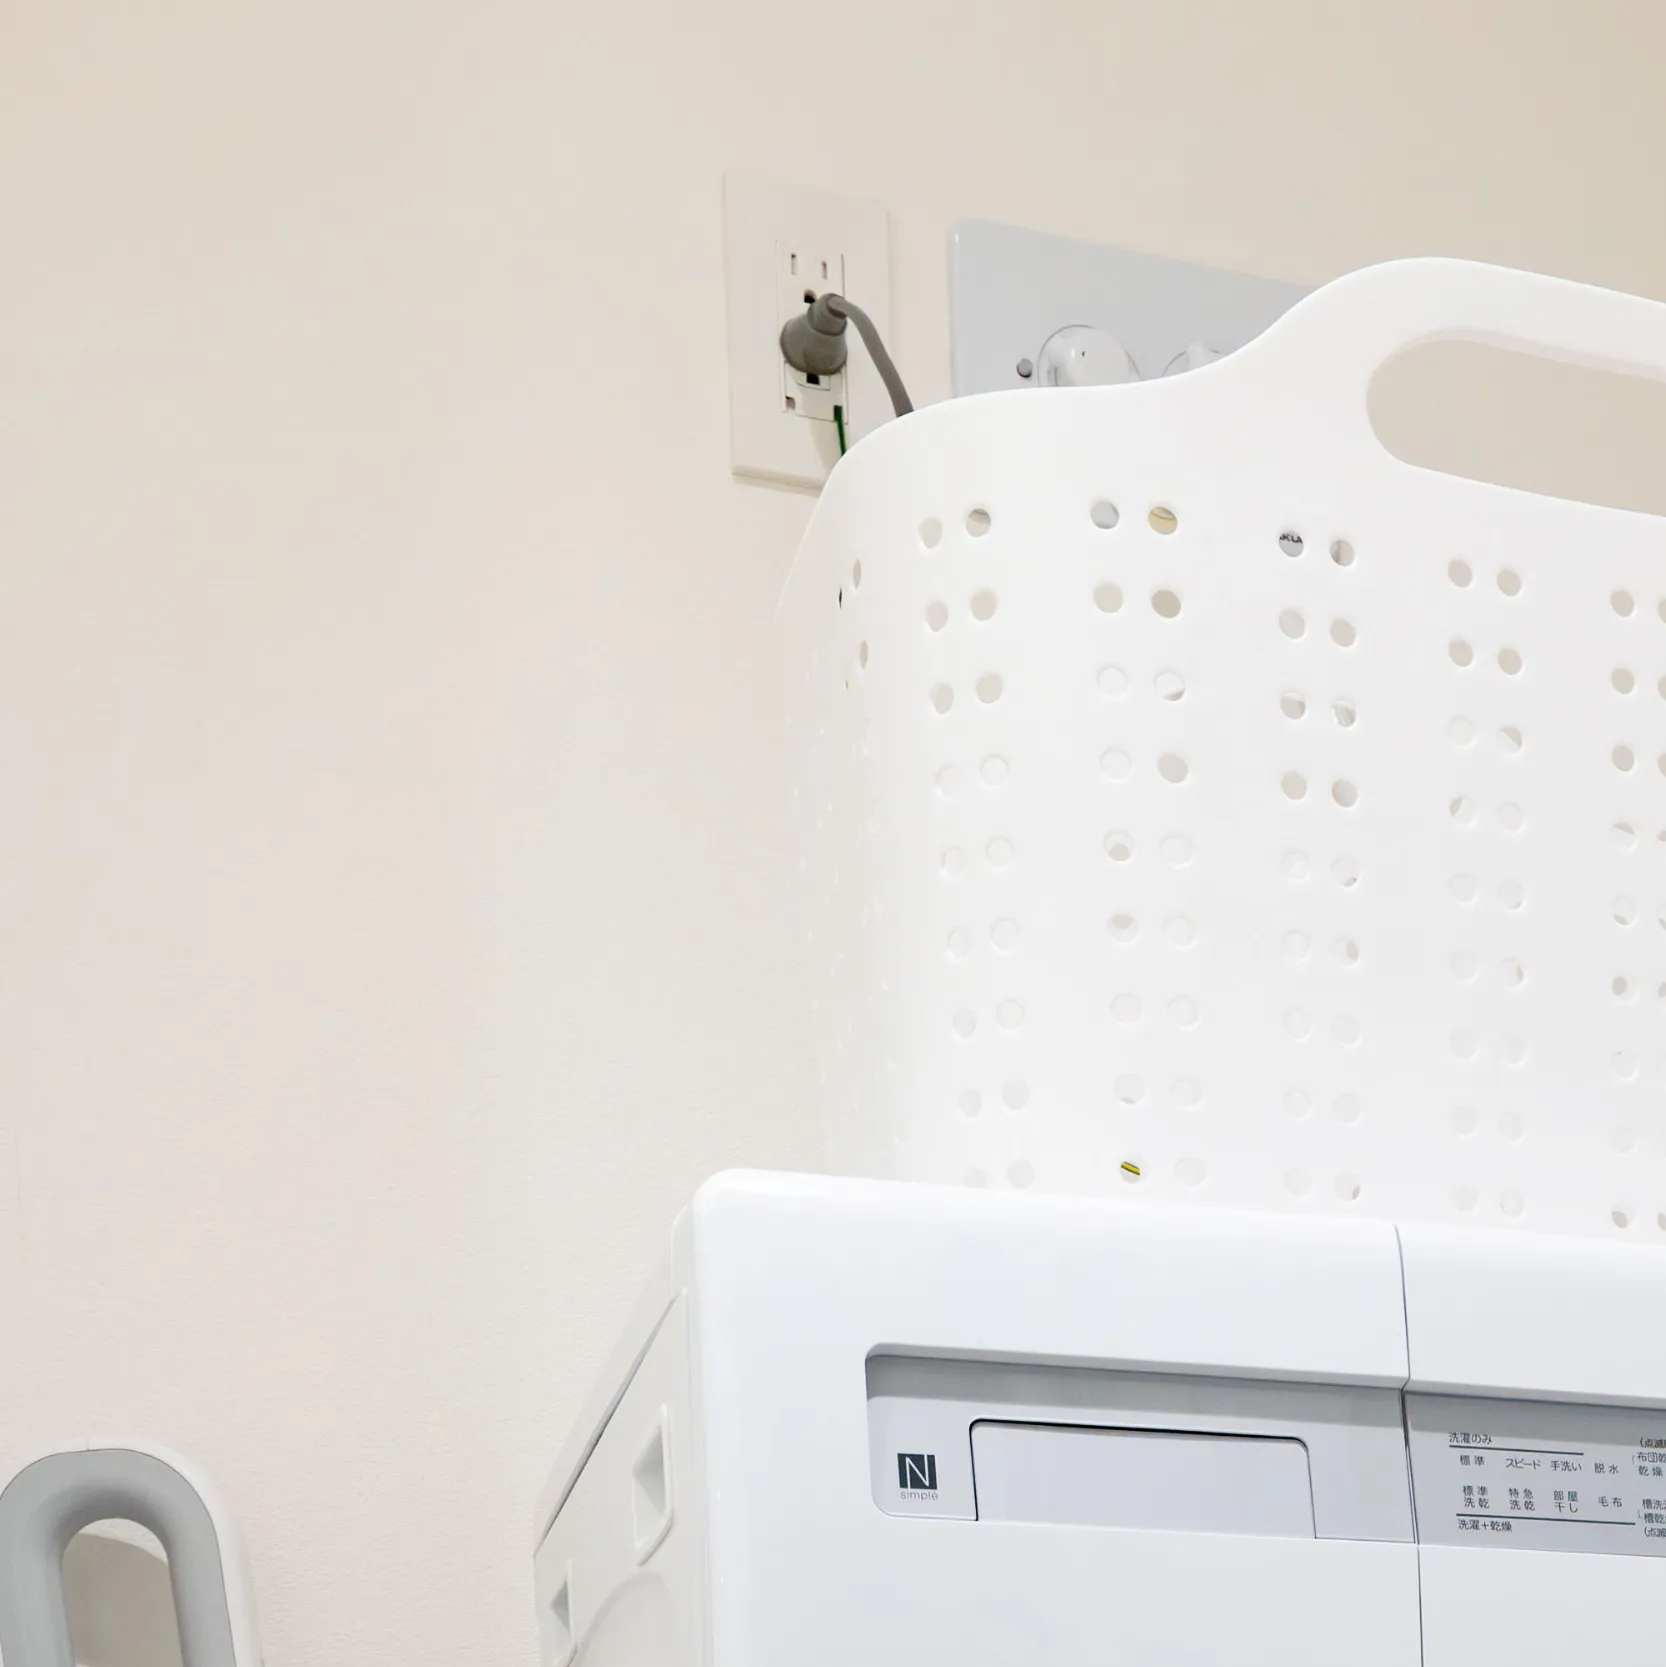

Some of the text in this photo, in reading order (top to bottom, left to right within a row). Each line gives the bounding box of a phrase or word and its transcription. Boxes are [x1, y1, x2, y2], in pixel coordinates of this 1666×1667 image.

[1449, 1432, 1493, 1444] 洗濯のみ
[1505, 1458, 1541, 1470] スピード
[1550, 1460, 1582, 1472] 手洗い
[1598, 1496, 1622, 1508] 毛布
